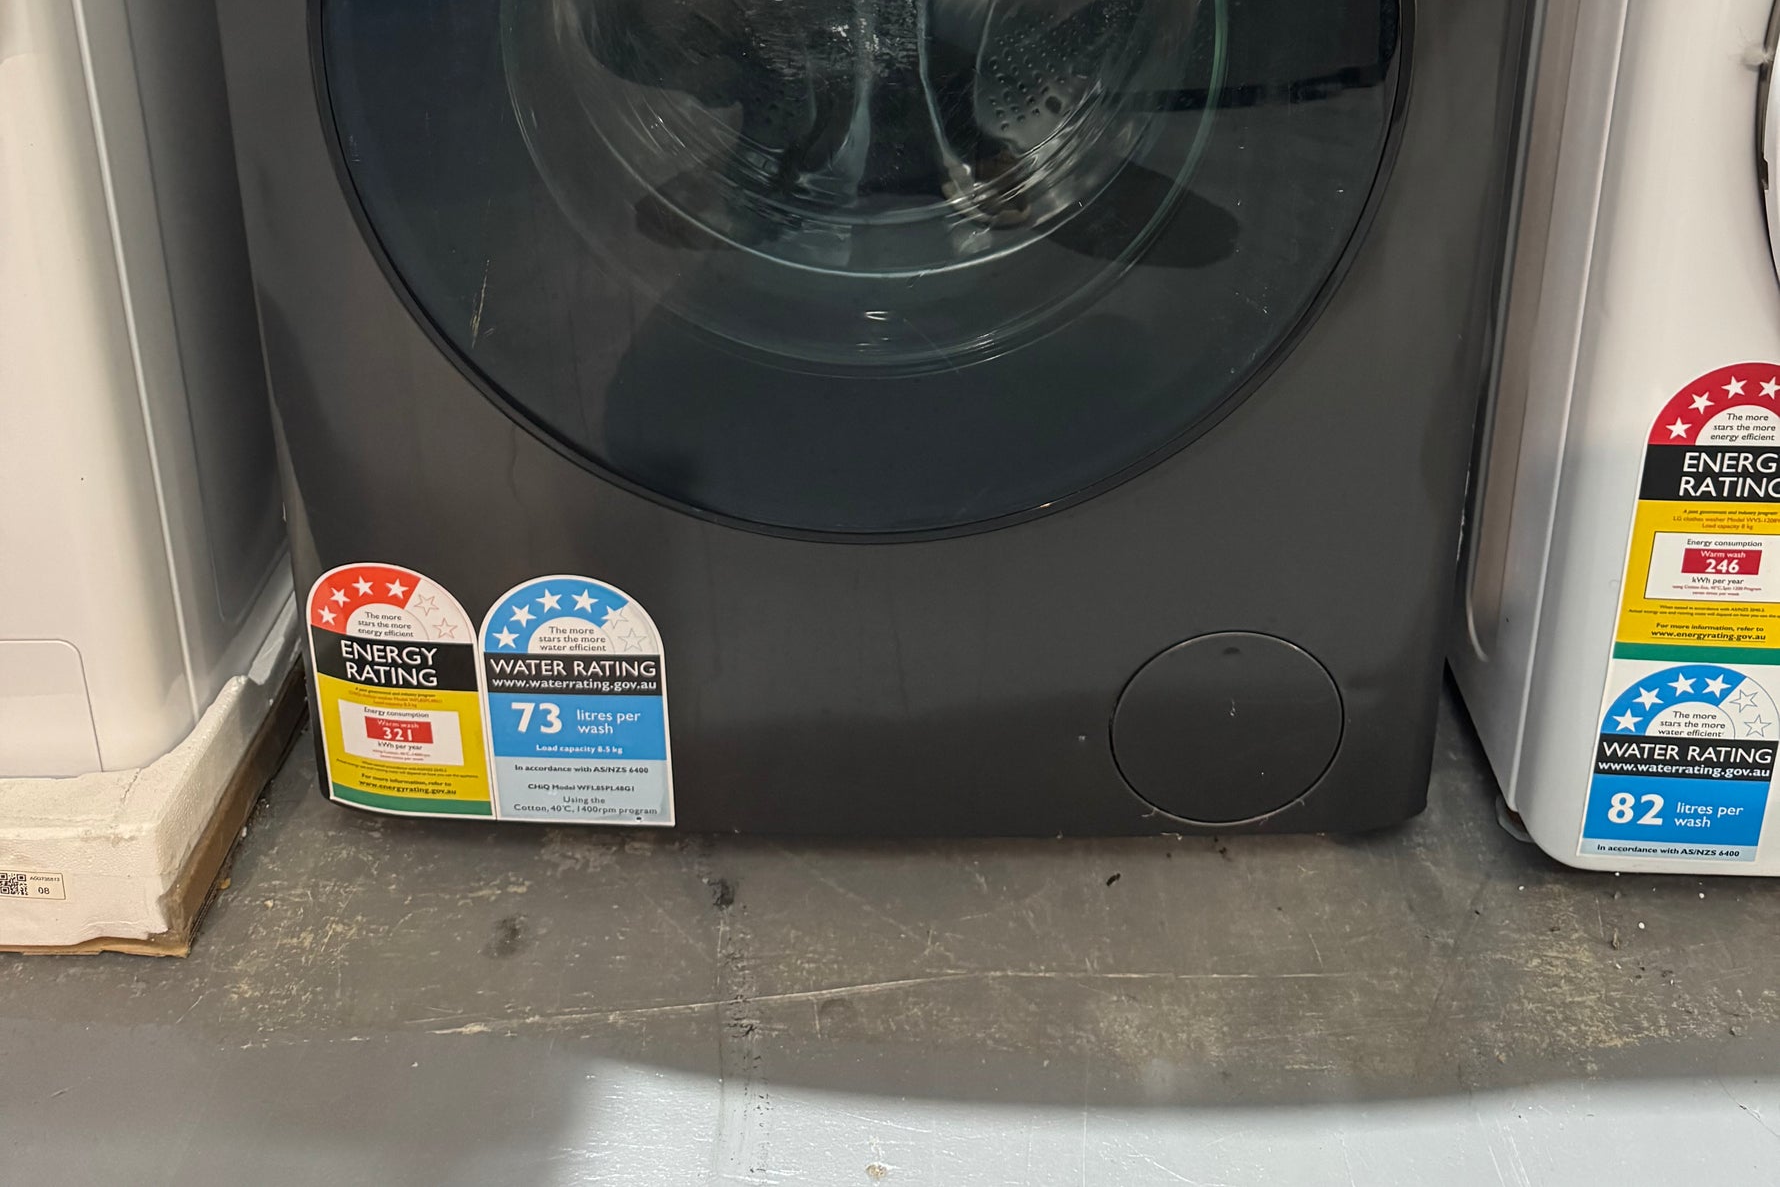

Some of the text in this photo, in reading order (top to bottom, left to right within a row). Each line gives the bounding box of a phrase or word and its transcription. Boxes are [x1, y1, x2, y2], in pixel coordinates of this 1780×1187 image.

[1727, 413, 1742, 421] The
[1711, 434, 1738, 442] energy
[1683, 452, 1780, 473] ENERG
[1687, 539, 1712, 547] Energy
[1705, 559, 1740, 573] 246
[358, 629, 382, 637] energy
[549, 626, 567, 634] The
[1651, 631, 1766, 641] www.energyrating.gov.au
[341, 640, 437, 665] ENERGY
[490, 659, 656, 677] WATER RATING
[346, 662, 437, 686] RATING
[492, 678, 657, 691] www.waterrating.gov.au
[364, 707, 385, 716] Energy
[577, 710, 640, 724] litres per
[1673, 711, 1690, 719] The
[511, 702, 562, 734] 73
[383, 727, 413, 741] 321
[578, 723, 613, 734] wash
[1687, 729, 1722, 737] efficient
[1603, 742, 1772, 764] WATER RATING
[1598, 762, 1770, 778] www.waterrating.gov.au
[563, 796, 589, 805] Using
[514, 804, 549, 812] Cotton,
[577, 806, 616, 814] 1400rpm
[1607, 792, 1664, 825] 82
[1676, 802, 1743, 818] litres per
[1675, 817, 1711, 827] wash
[1608, 845, 1657, 853] accordance
